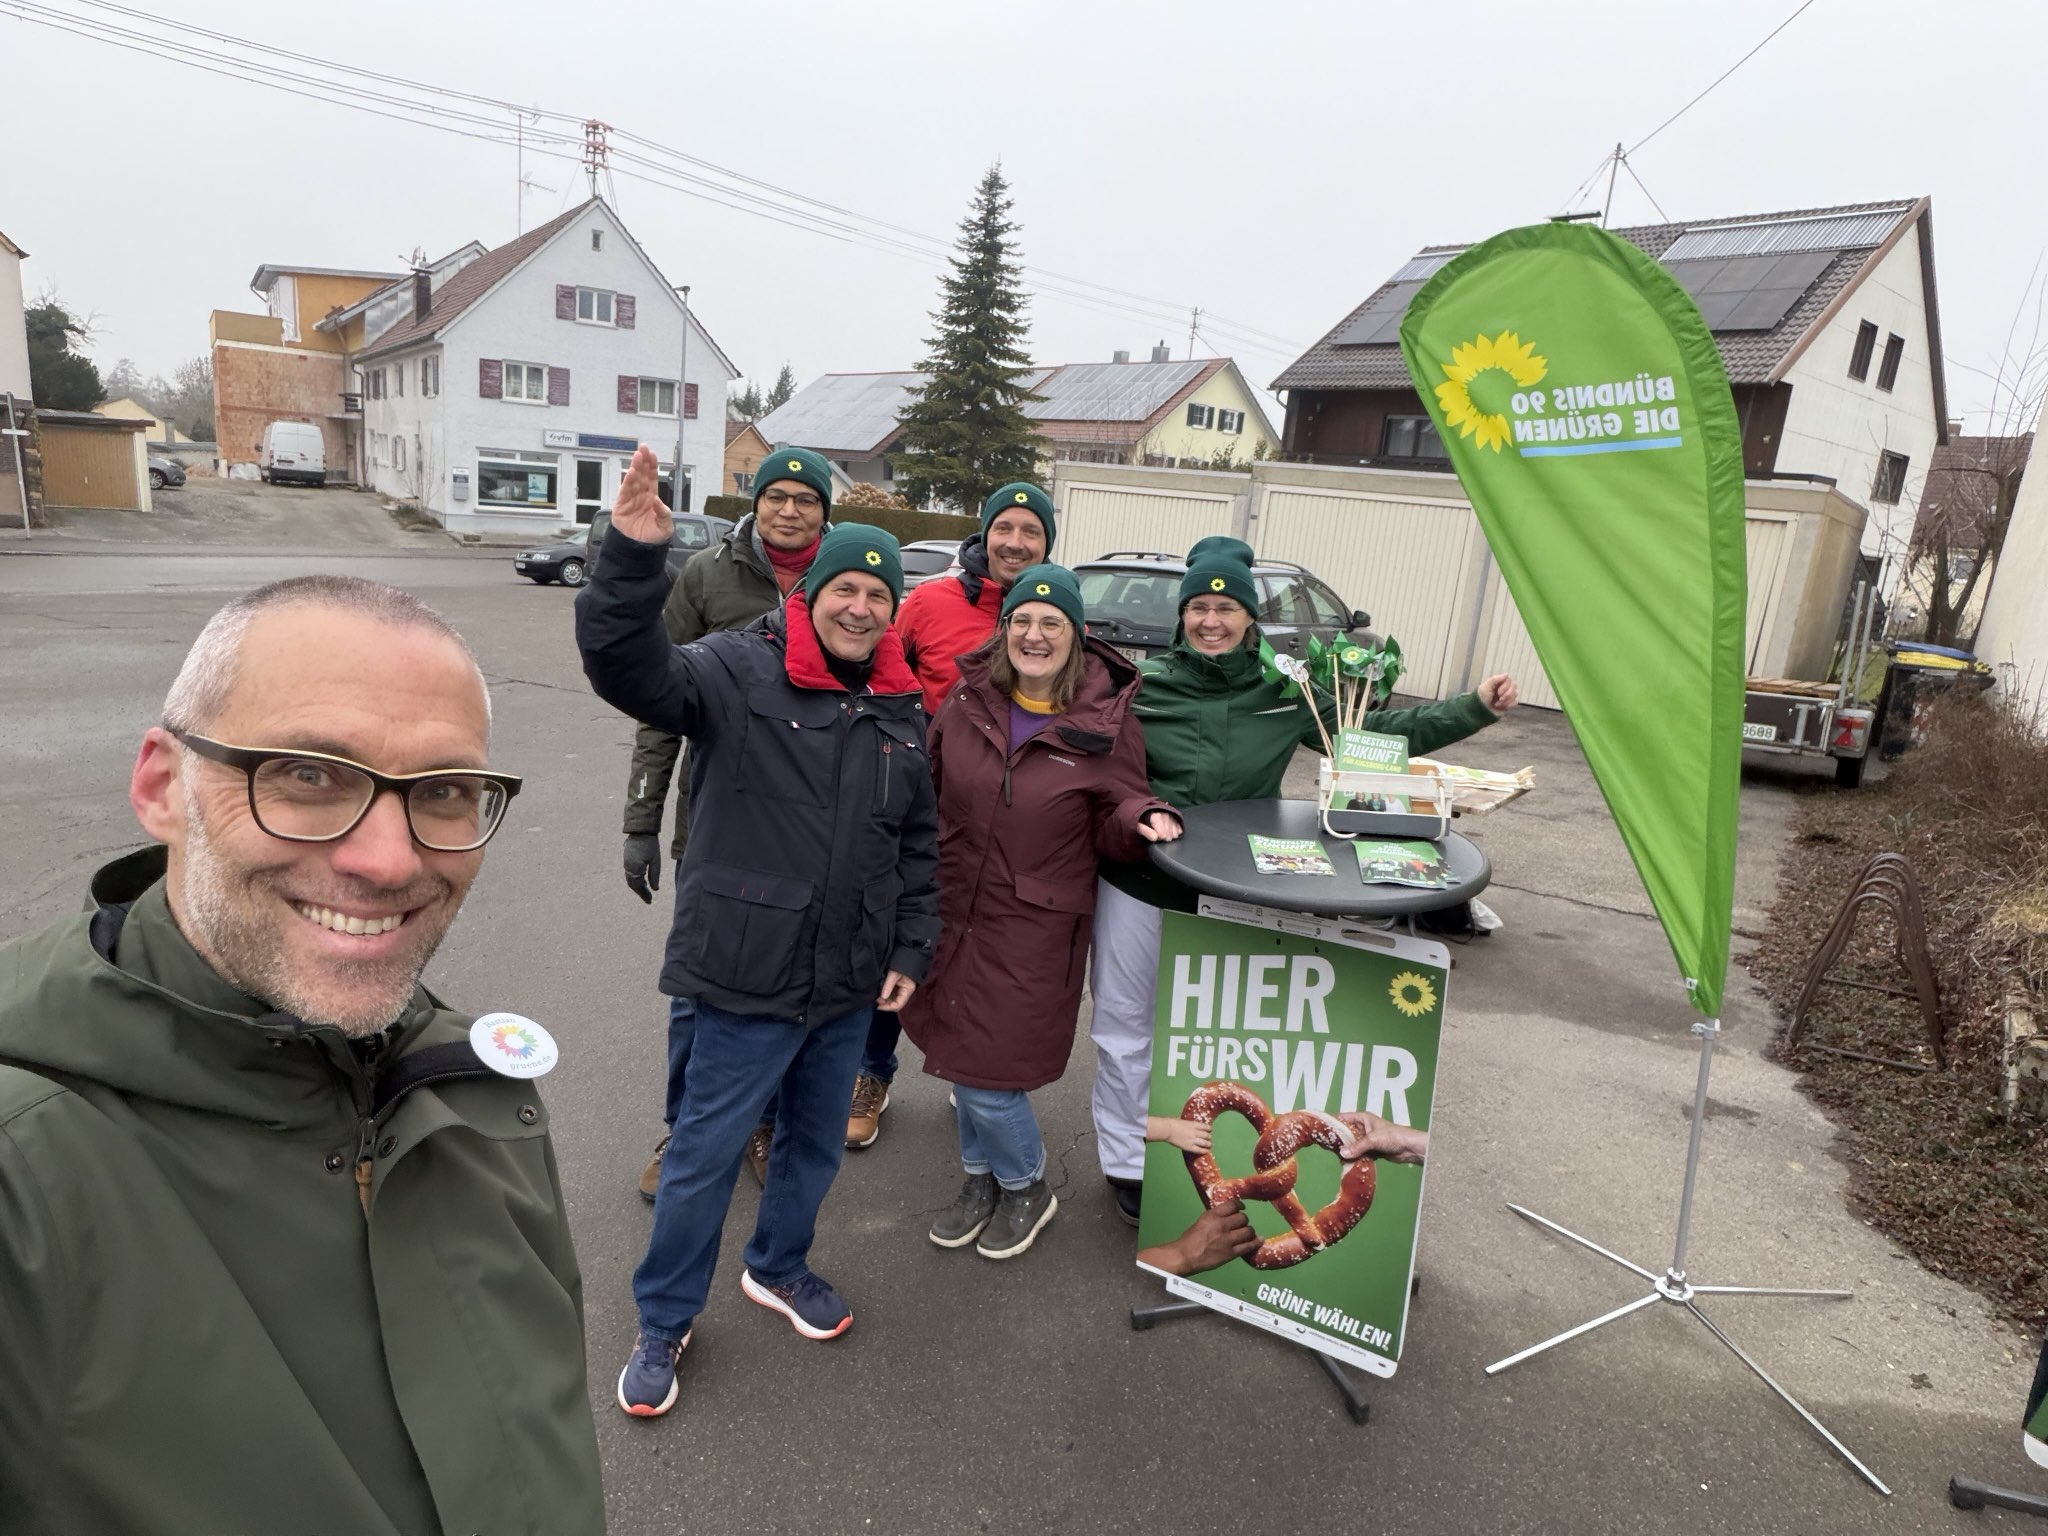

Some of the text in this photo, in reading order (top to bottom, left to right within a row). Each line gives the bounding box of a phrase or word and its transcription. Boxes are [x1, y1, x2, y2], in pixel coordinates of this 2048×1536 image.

[1345, 733, 1404, 751] WIR GESTALTEN
[1343, 743, 1402, 765] ZUKUNFT
[1254, 841, 1316, 850] ZUKUNFT
[1169, 954, 1336, 1034] HIER
[509, 1055, 553, 1071] gruene.de
[1166, 1035, 1418, 1127] FÜRS WIR
[1256, 1283, 1314, 1318] GRÜNE
[1313, 1304, 1393, 1351] WÄHLEN!
